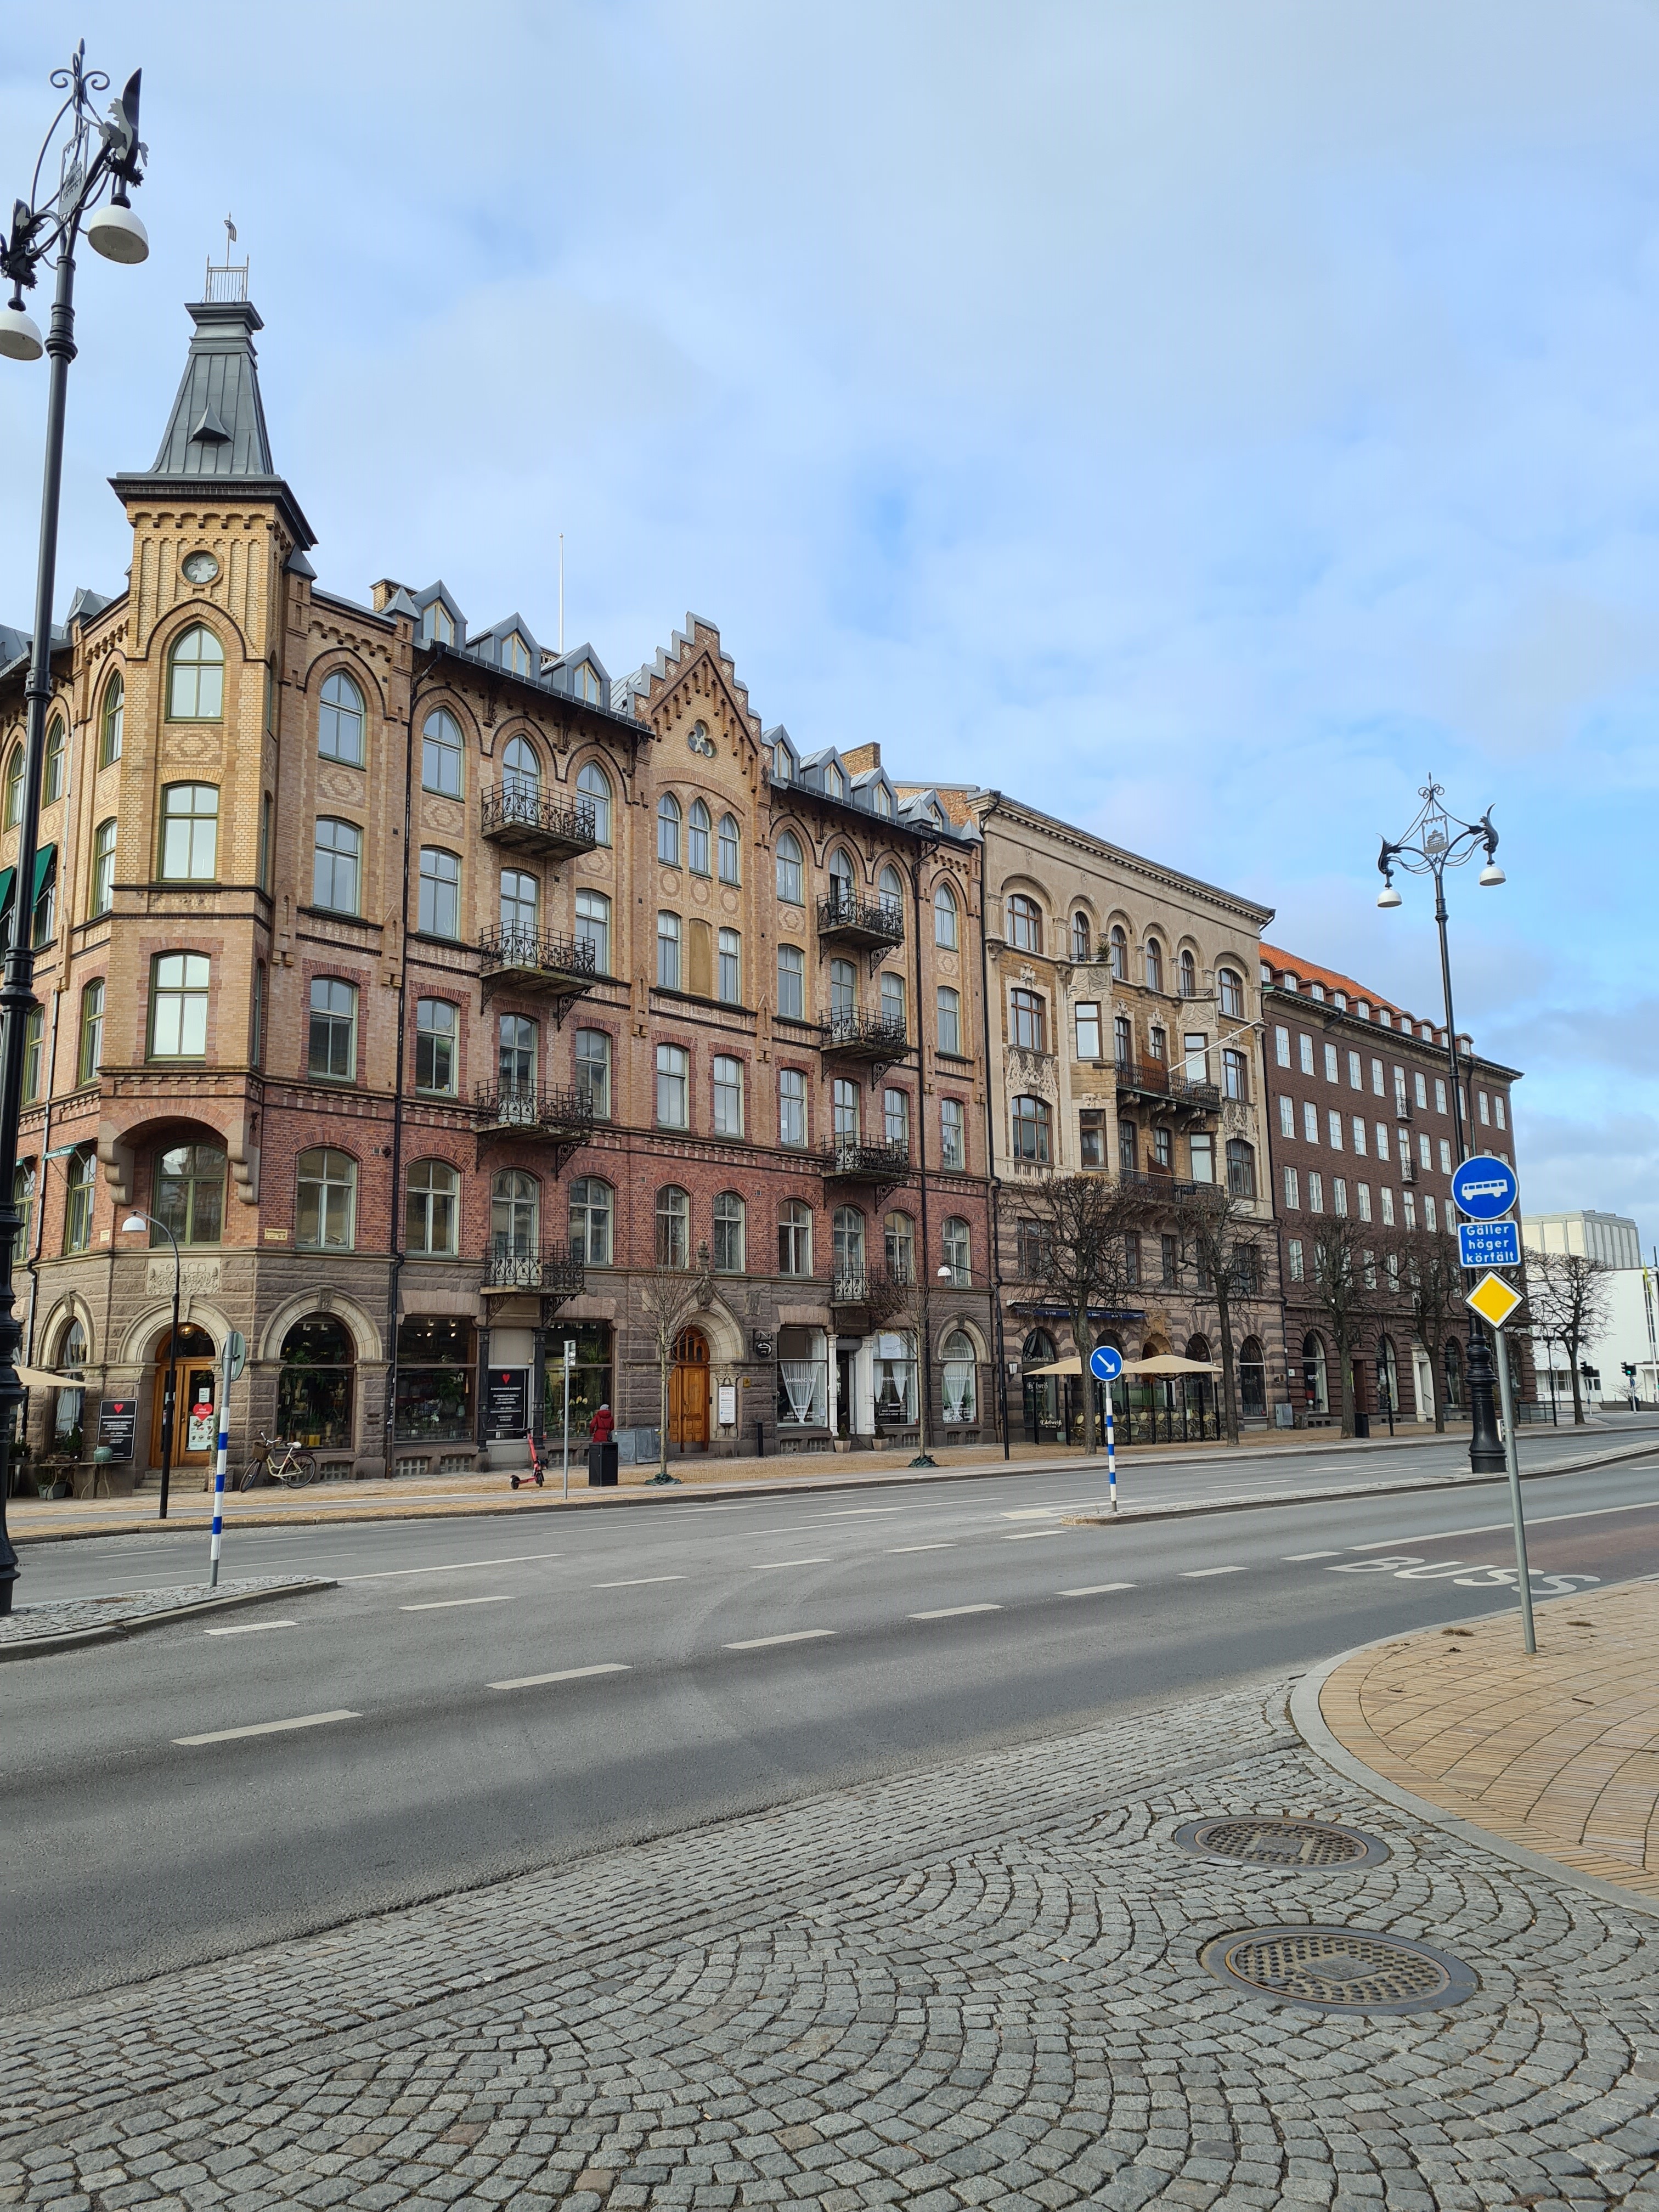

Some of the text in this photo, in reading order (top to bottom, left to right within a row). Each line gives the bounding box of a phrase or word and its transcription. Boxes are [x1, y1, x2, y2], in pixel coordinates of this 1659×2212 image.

[1466, 1224, 1509, 1236] Gäller
[1469, 1239, 1509, 1251] höger
[1466, 1251, 1514, 1263] körfält
[1323, 1555, 1601, 1595] BUSS
